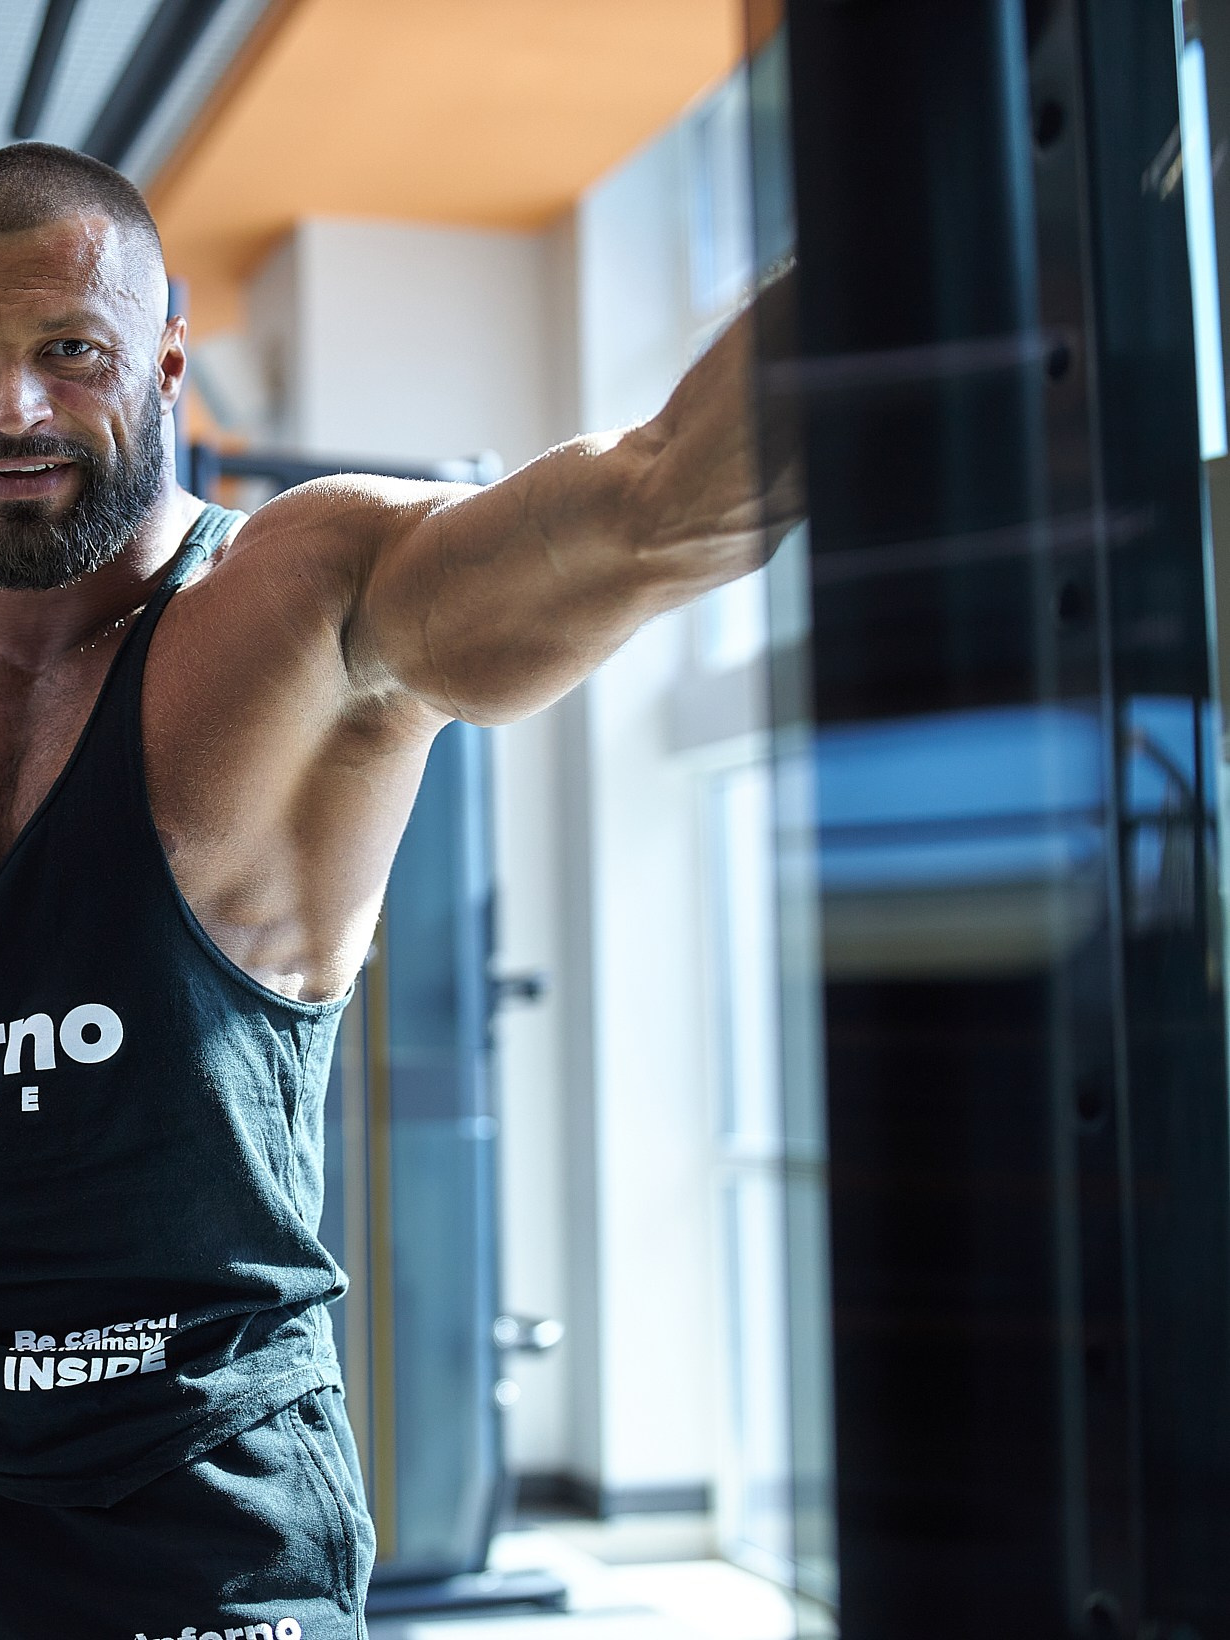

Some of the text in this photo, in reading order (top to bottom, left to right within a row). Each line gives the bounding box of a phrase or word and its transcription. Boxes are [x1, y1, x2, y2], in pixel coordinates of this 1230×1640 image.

[14, 1312, 178, 1352] Be careful
[3, 1340, 167, 1392] INSIDE
